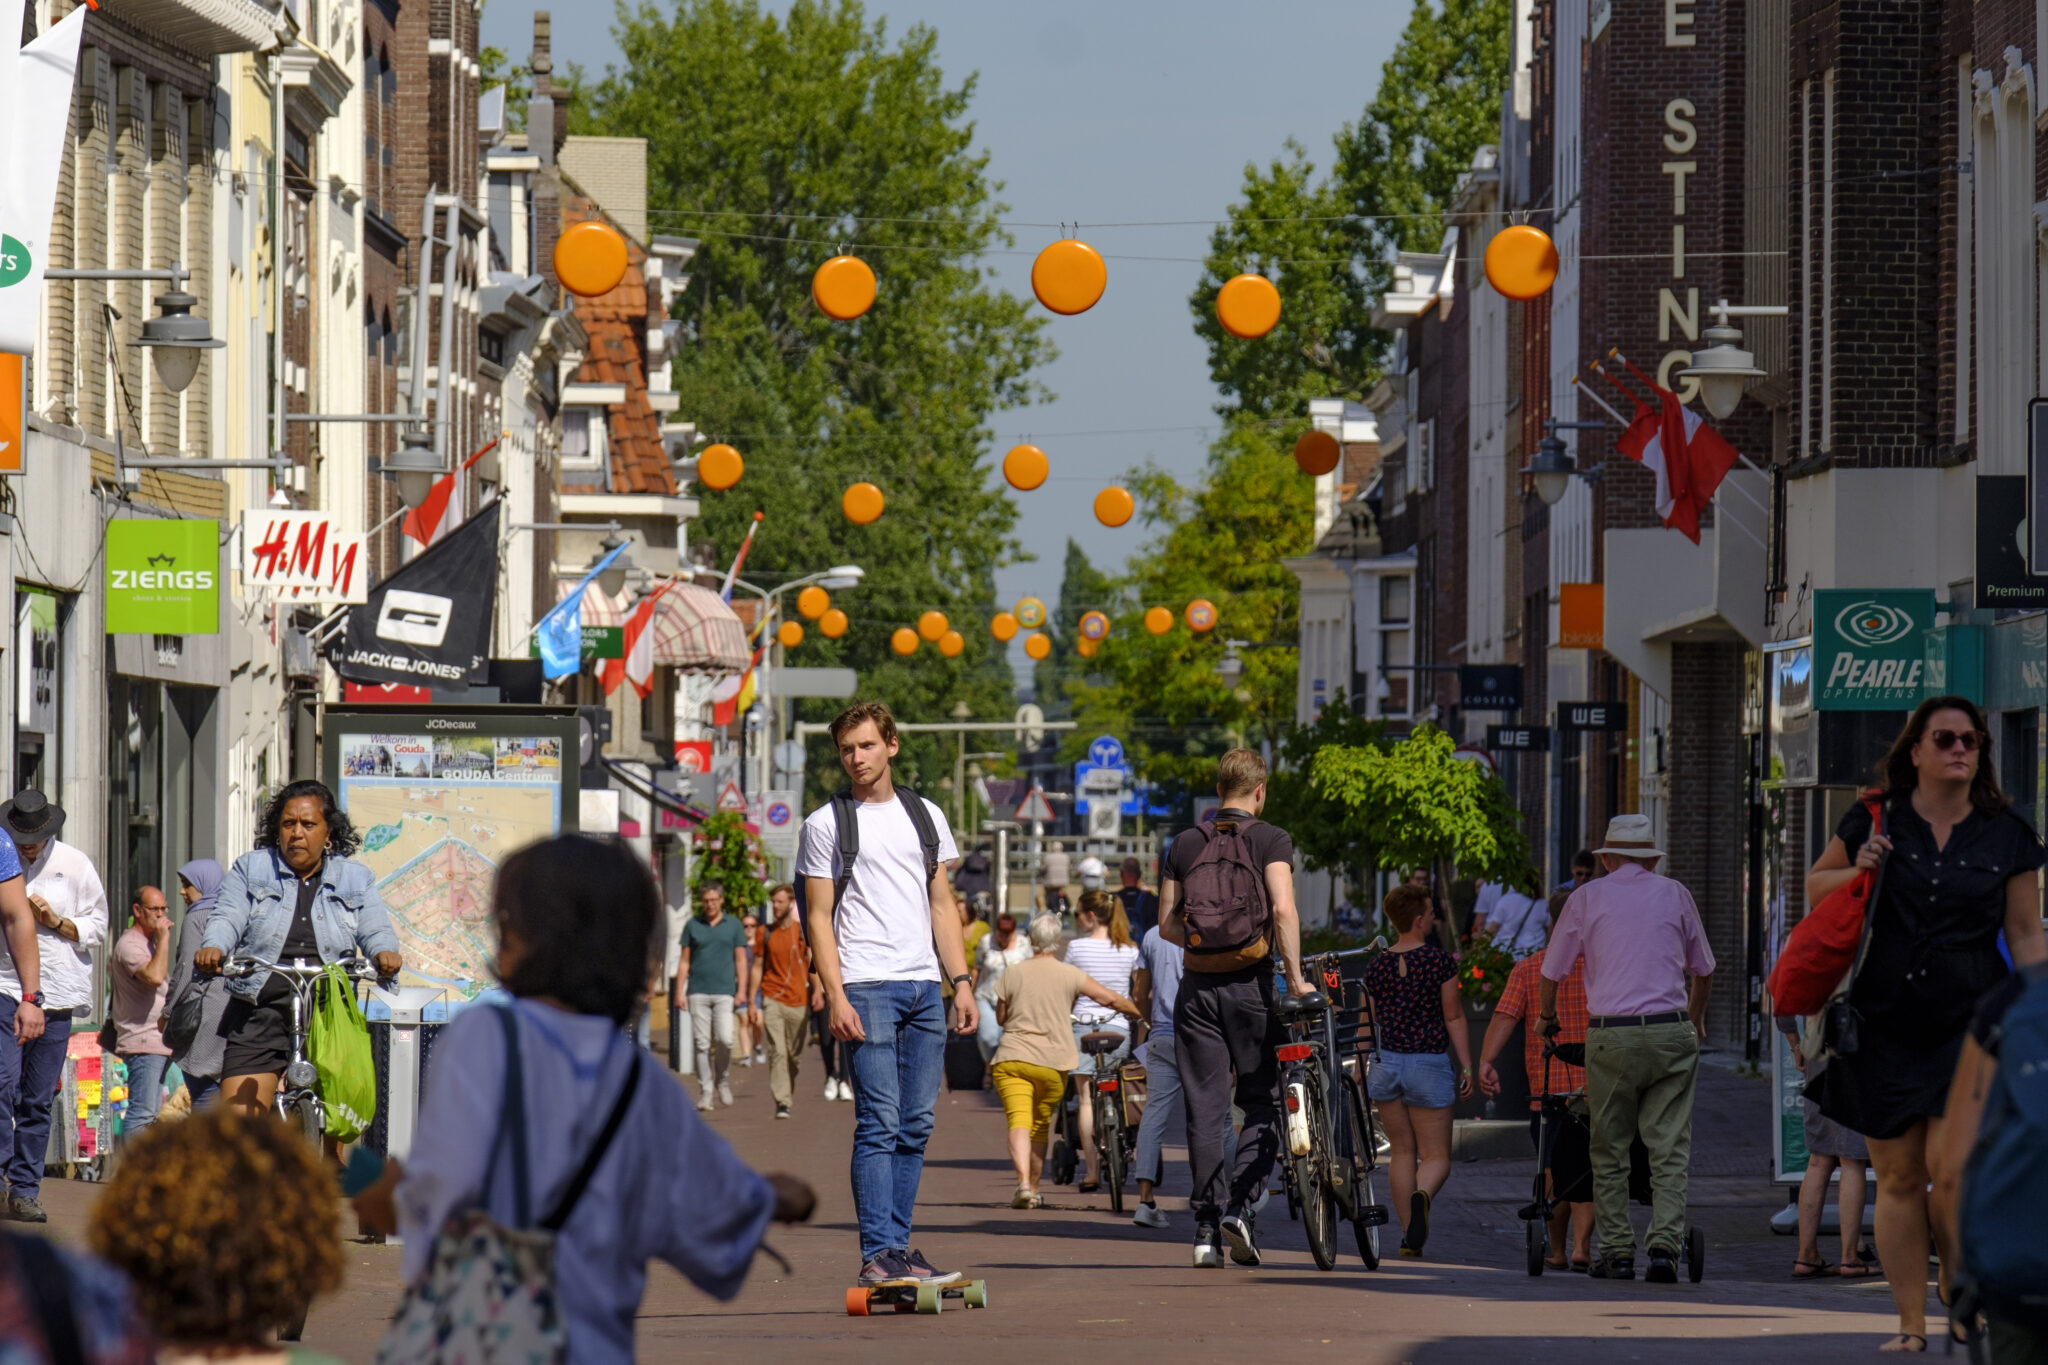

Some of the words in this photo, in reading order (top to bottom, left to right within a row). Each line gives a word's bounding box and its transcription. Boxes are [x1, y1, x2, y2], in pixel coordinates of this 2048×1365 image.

[1657, 98, 1700, 405] STING
[252, 519, 329, 581] H&M
[111, 570, 213, 589] ZIENGS
[1987, 584, 2045, 597] Premium
[347, 649, 393, 668] JACK
[407, 661, 461, 680] JONES
[1827, 651, 1923, 688] PEARLE
[1823, 688, 1916, 699] OPTICIENS
[425, 719, 476, 729] JCDecaux
[1572, 708, 1606, 725] WE
[370, 735, 407, 744] Welkom
[408, 735, 416, 744] in
[1499, 730, 1530, 745] WE
[394, 743, 425, 753] Gouda
[441, 769, 491, 780] GOUDA
[495, 770, 553, 781] Centrum
